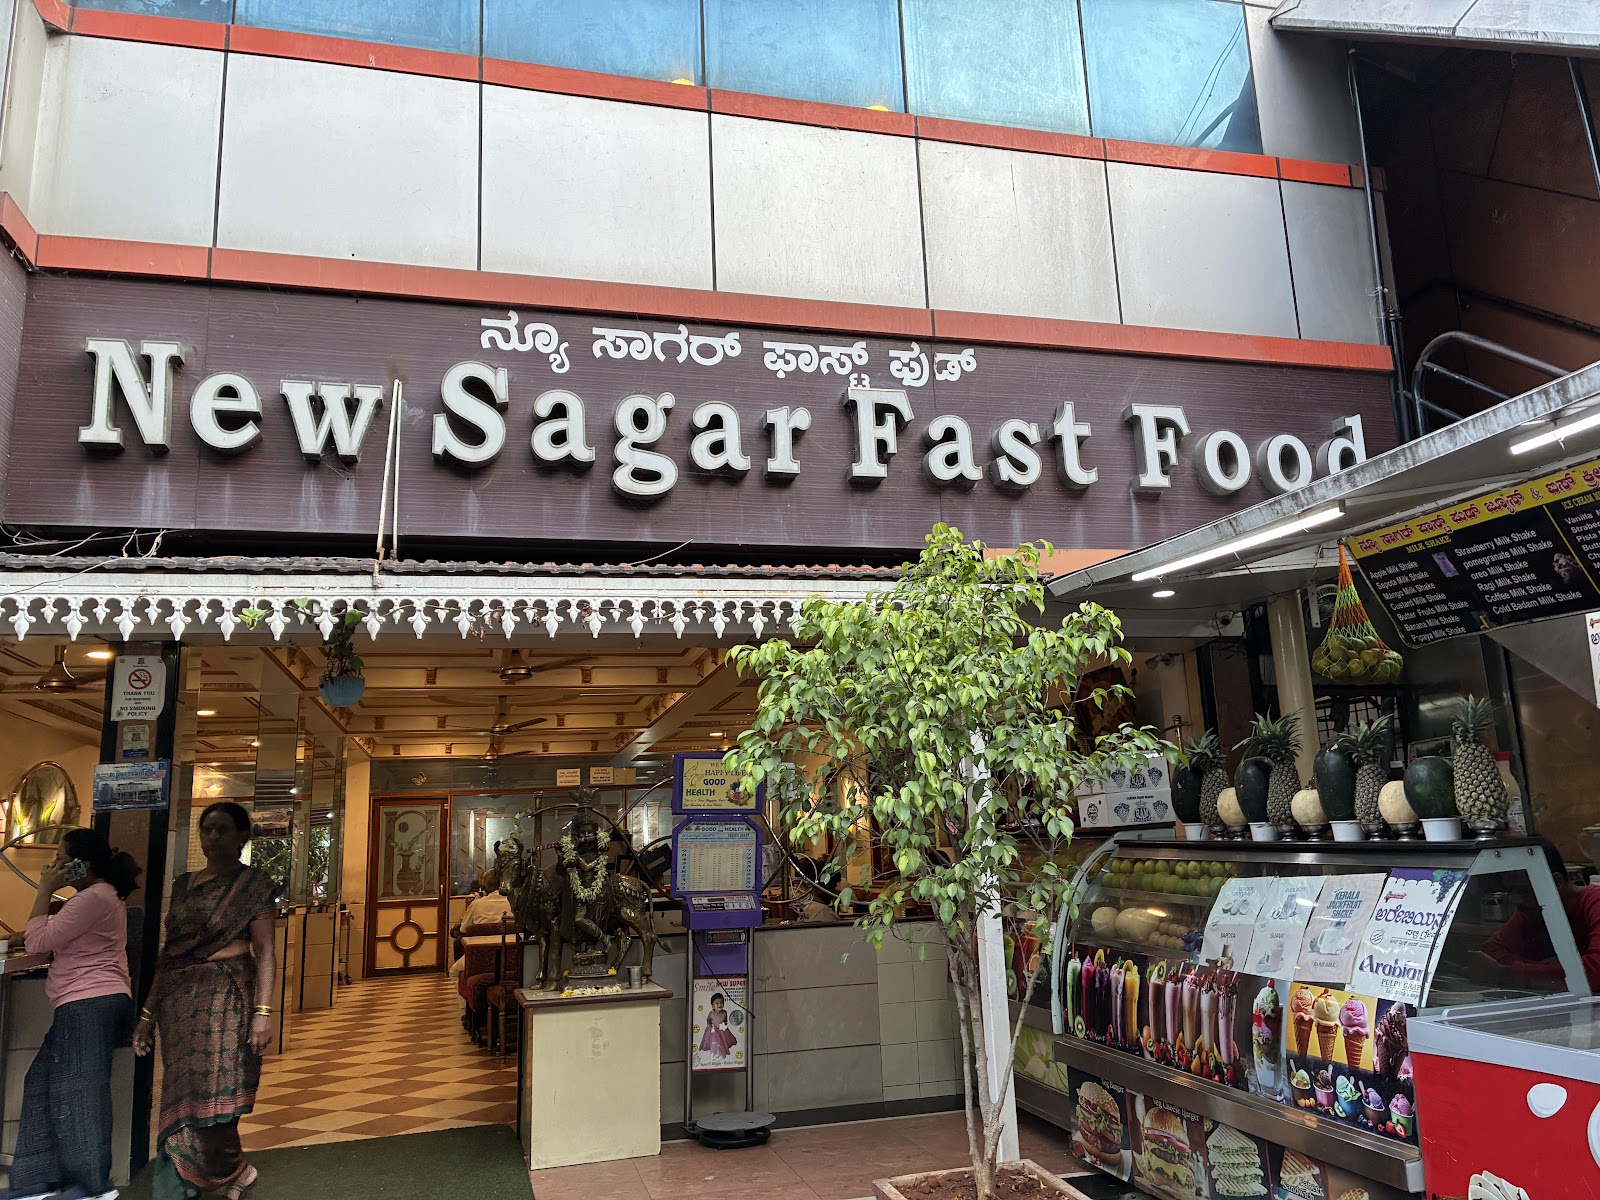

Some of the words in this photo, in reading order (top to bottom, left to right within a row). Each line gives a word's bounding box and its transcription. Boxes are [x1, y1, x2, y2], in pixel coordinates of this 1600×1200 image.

[480, 310, 570, 374] ನ್ಯೂ
[592, 323, 741, 366] ಸಾಗರ್
[78, 337, 384, 461] New
[432, 361, 811, 498] Sagar
[843, 386, 1098, 491] Fast
[1124, 403, 1368, 494] Food
[1530, 488, 1543, 500] &
[1561, 500, 1574, 510] ICE
[1564, 513, 1593, 524] Vanilla
[1405, 543, 1426, 554] MILK
[1425, 535, 1451, 549] SHAKE
[1454, 541, 1495, 557] Strawberry
[1494, 534, 1512, 546] Milk
[1511, 529, 1537, 542] Shake
[1576, 532, 1598, 542] Pista
[1463, 550, 1511, 570] pomegranate
[1509, 544, 1528, 557] Milk
[1527, 540, 1553, 553] Shake
[1370, 568, 1387, 580] Apple
[1387, 564, 1399, 575] Milk
[1399, 561, 1418, 571] Shake
[1470, 570, 1488, 580] oreo
[1487, 564, 1505, 576] Milk
[1503, 560, 1528, 573] Shake
[1376, 578, 1397, 590] Sapota
[1397, 574, 1410, 585] Milk
[1409, 570, 1429, 581] Shake
[1477, 579, 1496, 592] Ragi
[1495, 576, 1512, 589] Milk
[1511, 572, 1537, 585] Shake
[1382, 590, 1404, 600] Mango
[1402, 585, 1416, 596] Milk
[1415, 582, 1436, 592] Shake
[1484, 591, 1510, 603] Coffee
[1509, 587, 1527, 599] Milk
[1526, 583, 1552, 595] Shake
[1390, 599, 1415, 611] Custard
[1413, 596, 1427, 606] Milk
[1426, 592, 1446, 603] Shake
[1397, 610, 1416, 621] Butter
[1417, 606, 1436, 617] Fruits
[1435, 603, 1449, 613] Milk
[1448, 600, 1469, 611] Shake
[1492, 603, 1511, 615] Cold
[1512, 599, 1539, 611] Badam
[1537, 595, 1556, 606] Milk
[1555, 591, 1582, 602] Shake
[1404, 621, 1428, 631] Banana
[1426, 617, 1440, 627] Milk
[1439, 614, 1460, 625] Shake
[1411, 632, 1433, 642] Papaya
[1432, 629, 1447, 638] Milk
[1446, 626, 1466, 636] Shake
[686, 788, 715, 796] HEALTH
[1334, 890, 1360, 899] KERALA
[1327, 900, 1362, 910] JACKFRUIT
[1331, 910, 1354, 918] SHAKE
[694, 981, 716, 992] Smile
[1381, 978, 1403, 987] PULPY
